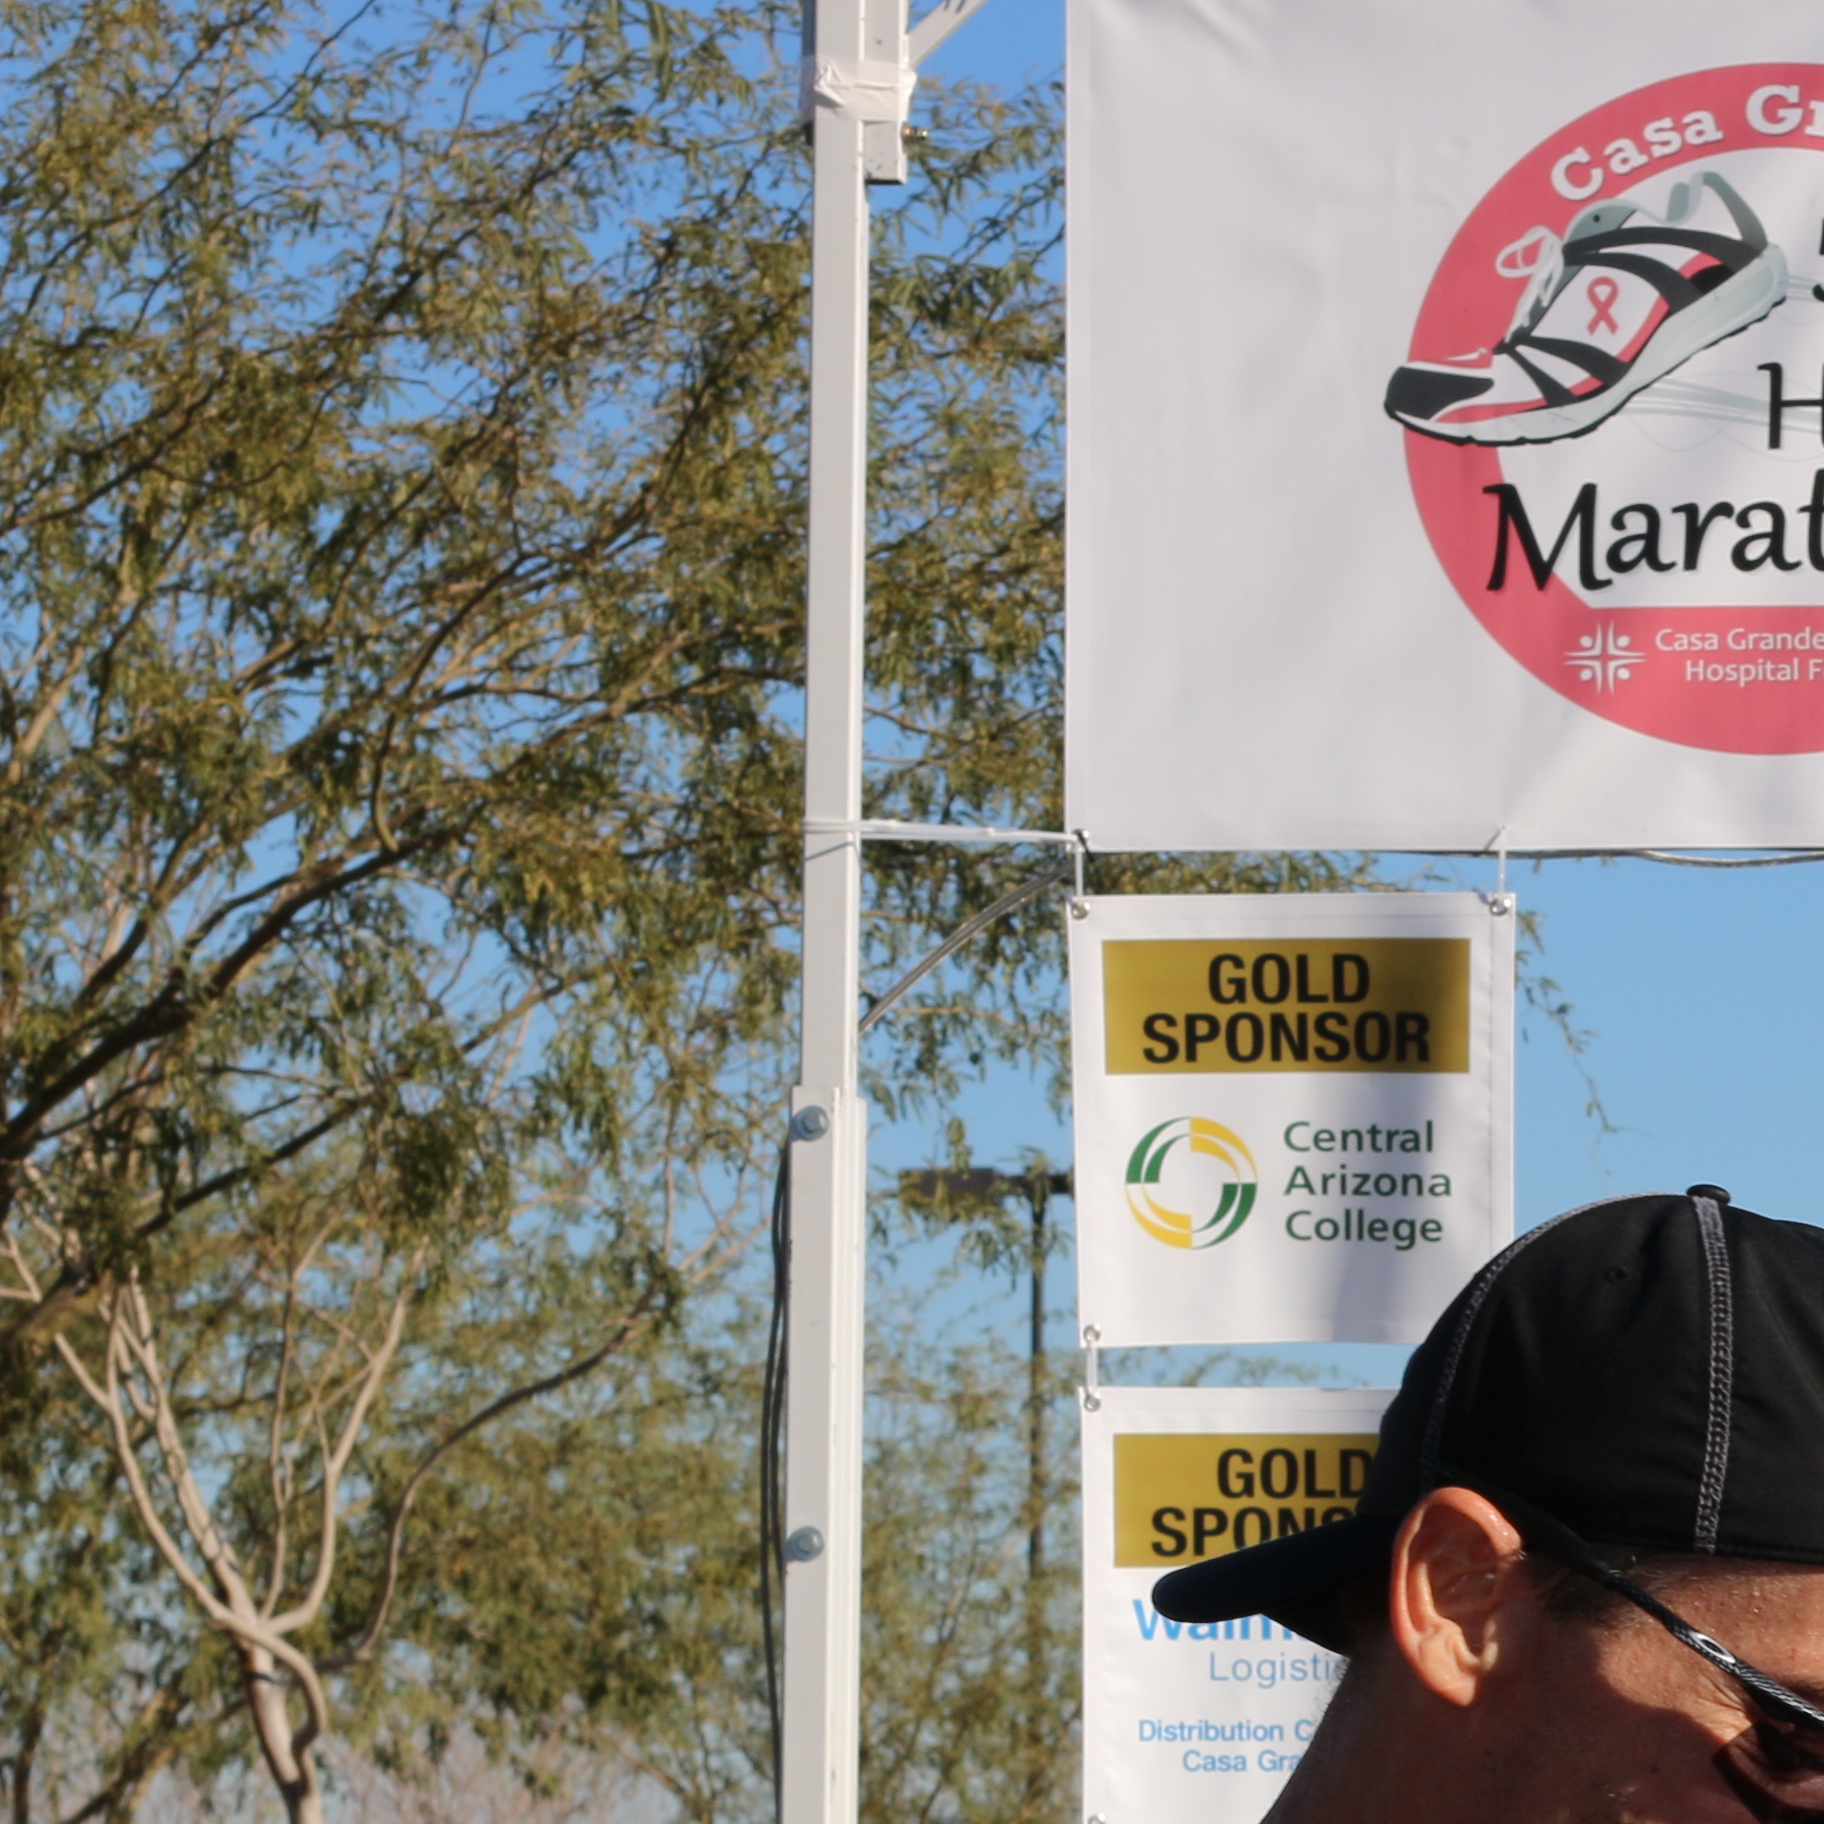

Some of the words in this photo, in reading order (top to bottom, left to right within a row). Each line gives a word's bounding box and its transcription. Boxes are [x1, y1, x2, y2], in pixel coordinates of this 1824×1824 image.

[1551, 107, 1723, 201] Casa
[1655, 629, 1721, 652] Casa
[1685, 657, 1799, 686] Hospital
[1208, 953, 1370, 1005] GOLD
[1142, 1012, 1430, 1064] SPONSOR
[1283, 1120, 1434, 1153] Central
[1283, 1164, 1452, 1197] Arizona
[1285, 1208, 1443, 1251] College
[1217, 1449, 1375, 1498] GOLD
[1151, 1507, 1355, 1557] SPON
[1210, 1652, 1348, 1689] Logisti
[1139, 1719, 1284, 1742] Distribution
[1182, 1749, 1247, 1772] Casa
[1258, 1749, 1302, 1772] Gra
